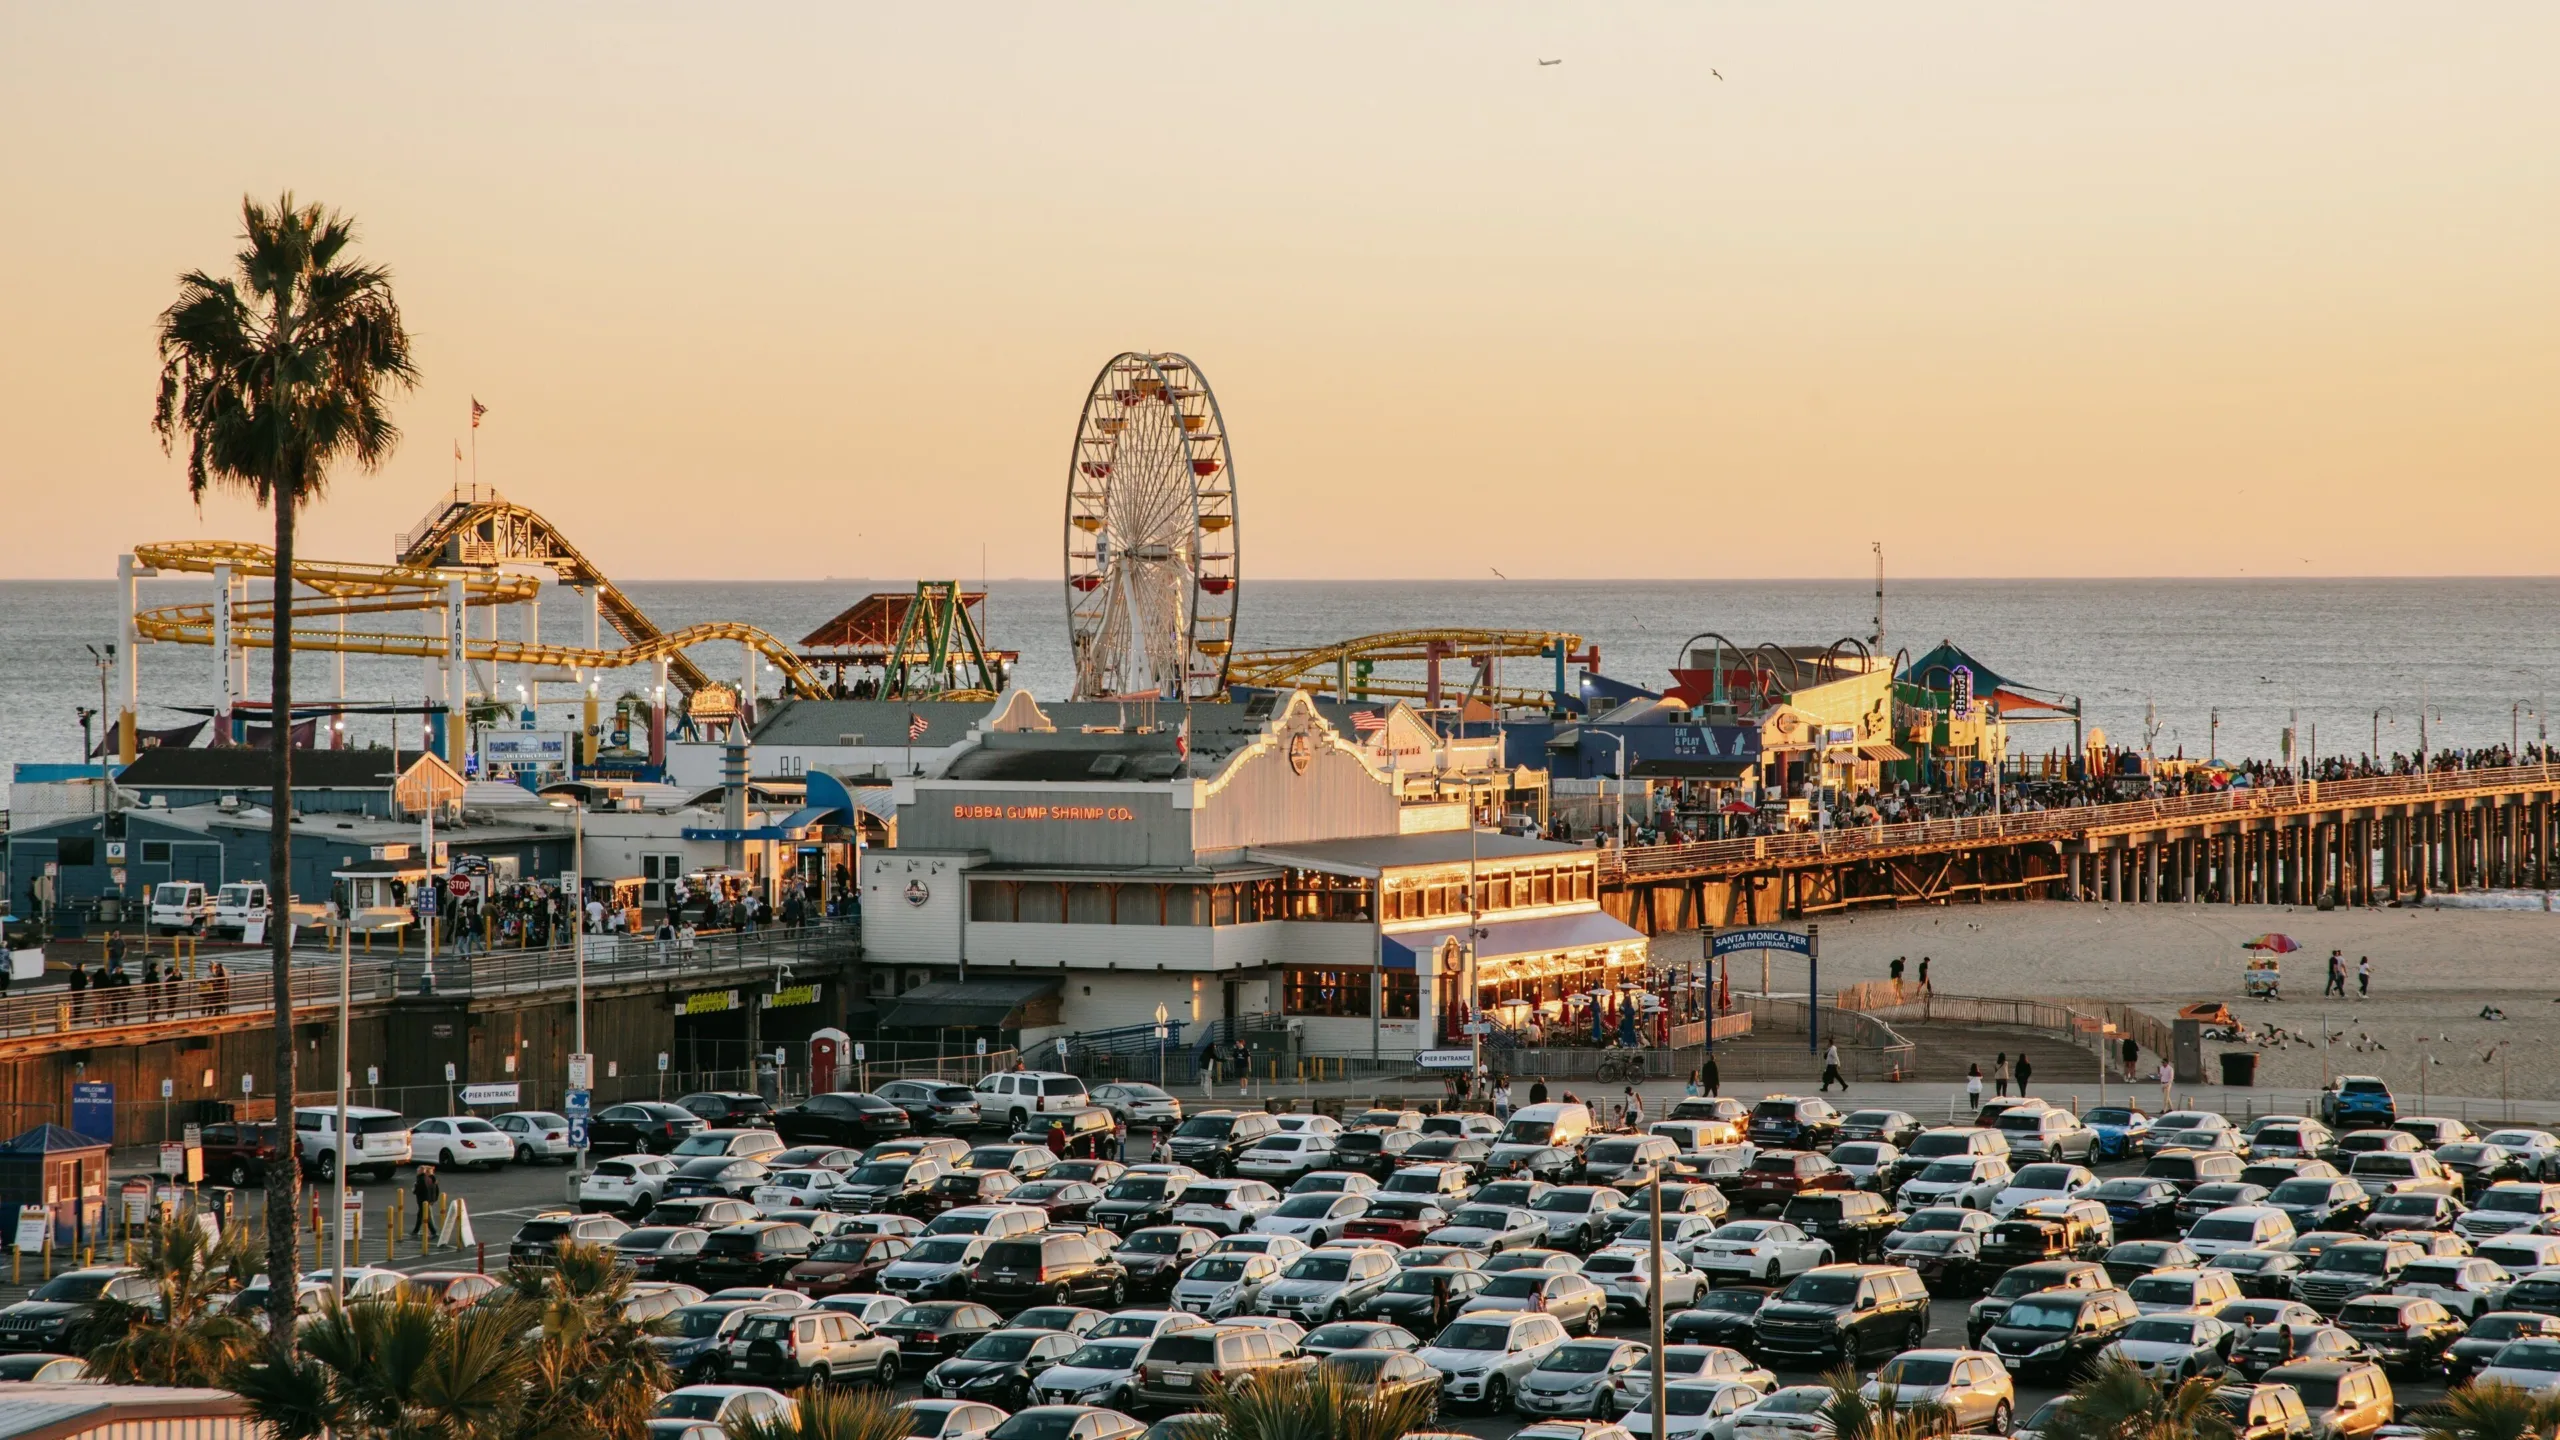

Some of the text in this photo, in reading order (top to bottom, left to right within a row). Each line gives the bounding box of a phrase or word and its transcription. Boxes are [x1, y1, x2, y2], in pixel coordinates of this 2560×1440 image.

[1675, 728, 1687, 737] EAT
[1675, 737, 1700, 746] & PLAY
[954, 806, 1133, 821] BUBBA GUMP SHRIMP CO.
[450, 880, 470, 890] STOP
[566, 882, 572, 891] 5
[1715, 932, 1807, 947] SANTA MONICA PIER
[1732, 941, 1790, 949] NORTH ENTRANCE
[483, 1090, 516, 1098] ENTRANCE
[571, 1118, 585, 1142] 5
